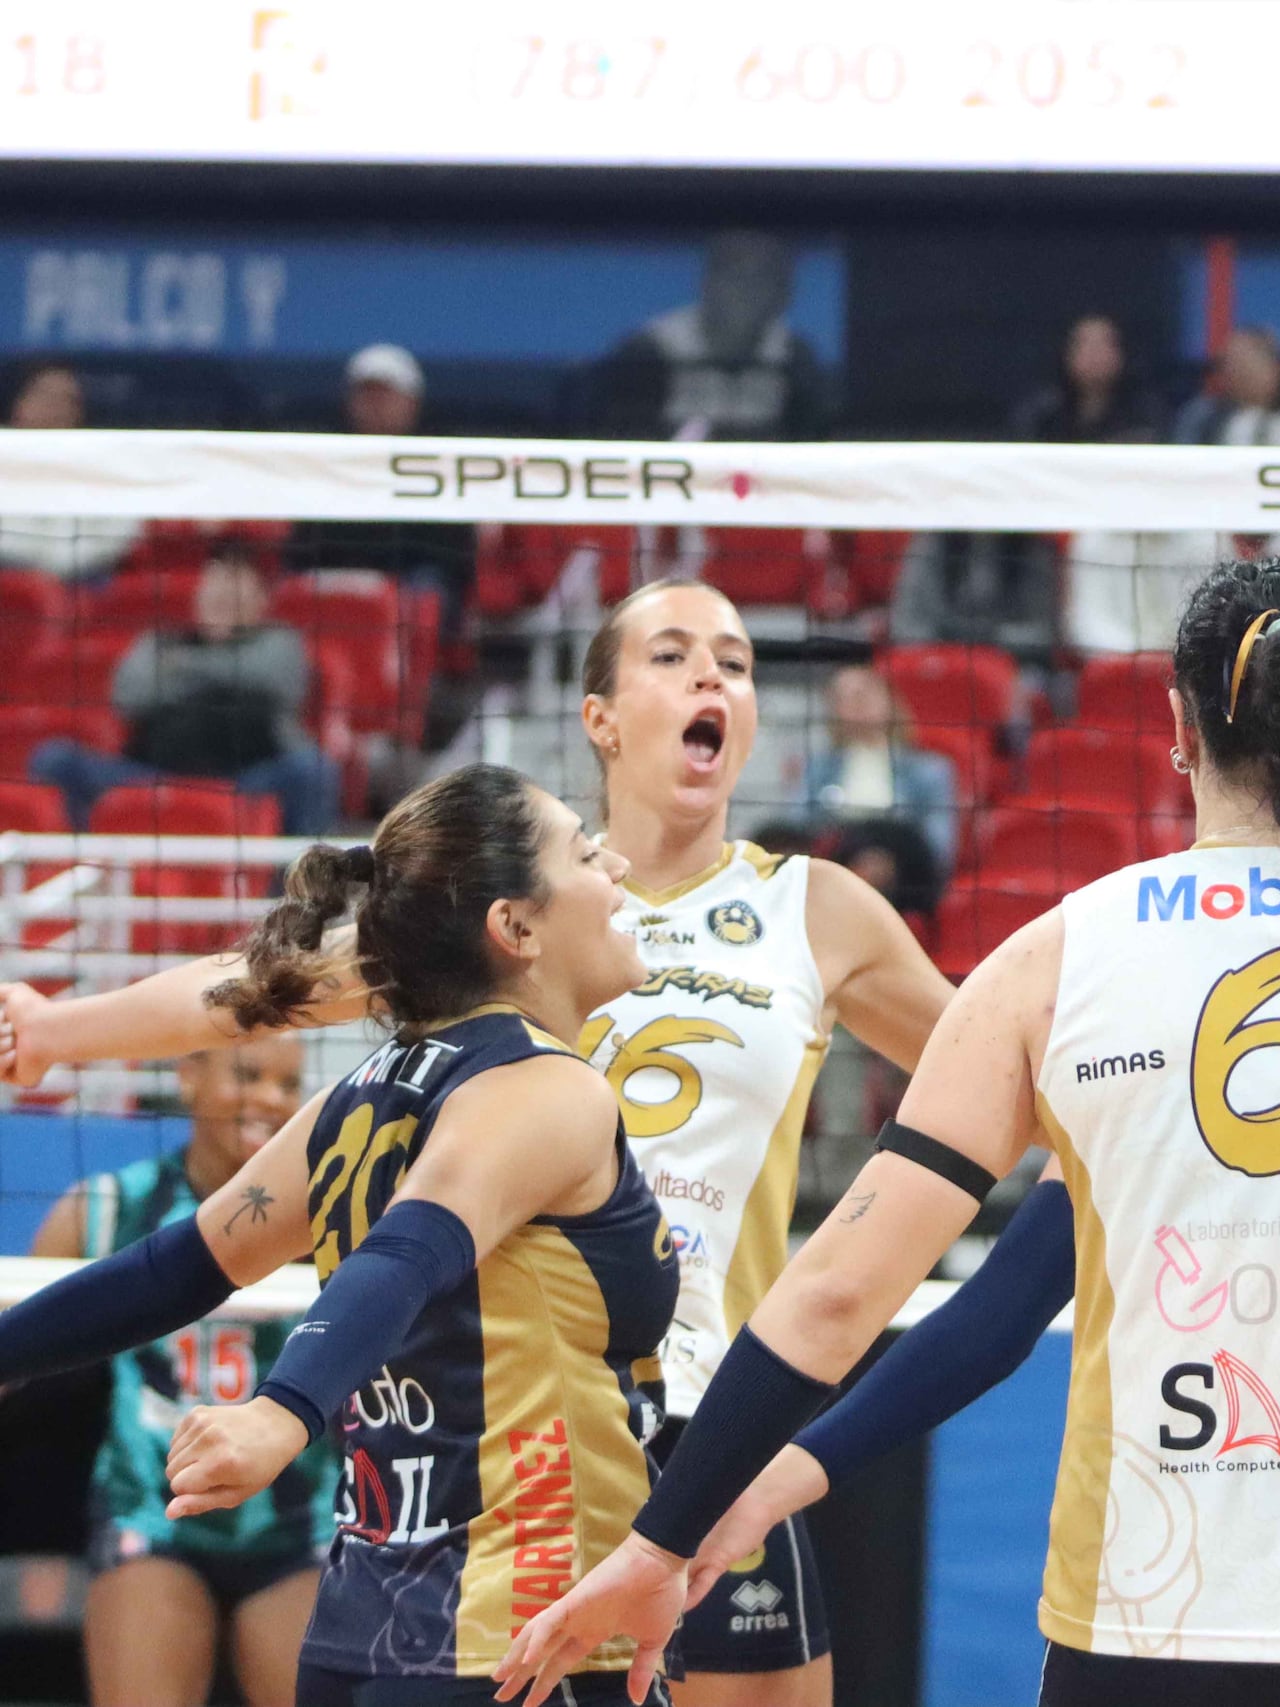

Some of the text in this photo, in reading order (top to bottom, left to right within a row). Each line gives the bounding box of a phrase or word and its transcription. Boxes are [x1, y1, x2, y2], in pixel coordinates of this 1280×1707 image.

[733, 42, 907, 106] 600
[958, 38, 1190, 110] 2052
[25, 251, 226, 348] PALCO
[174, 1329, 254, 1402] 15
[1159, 1462, 1210, 1474] Health
[731, 1612, 789, 1632] errea
